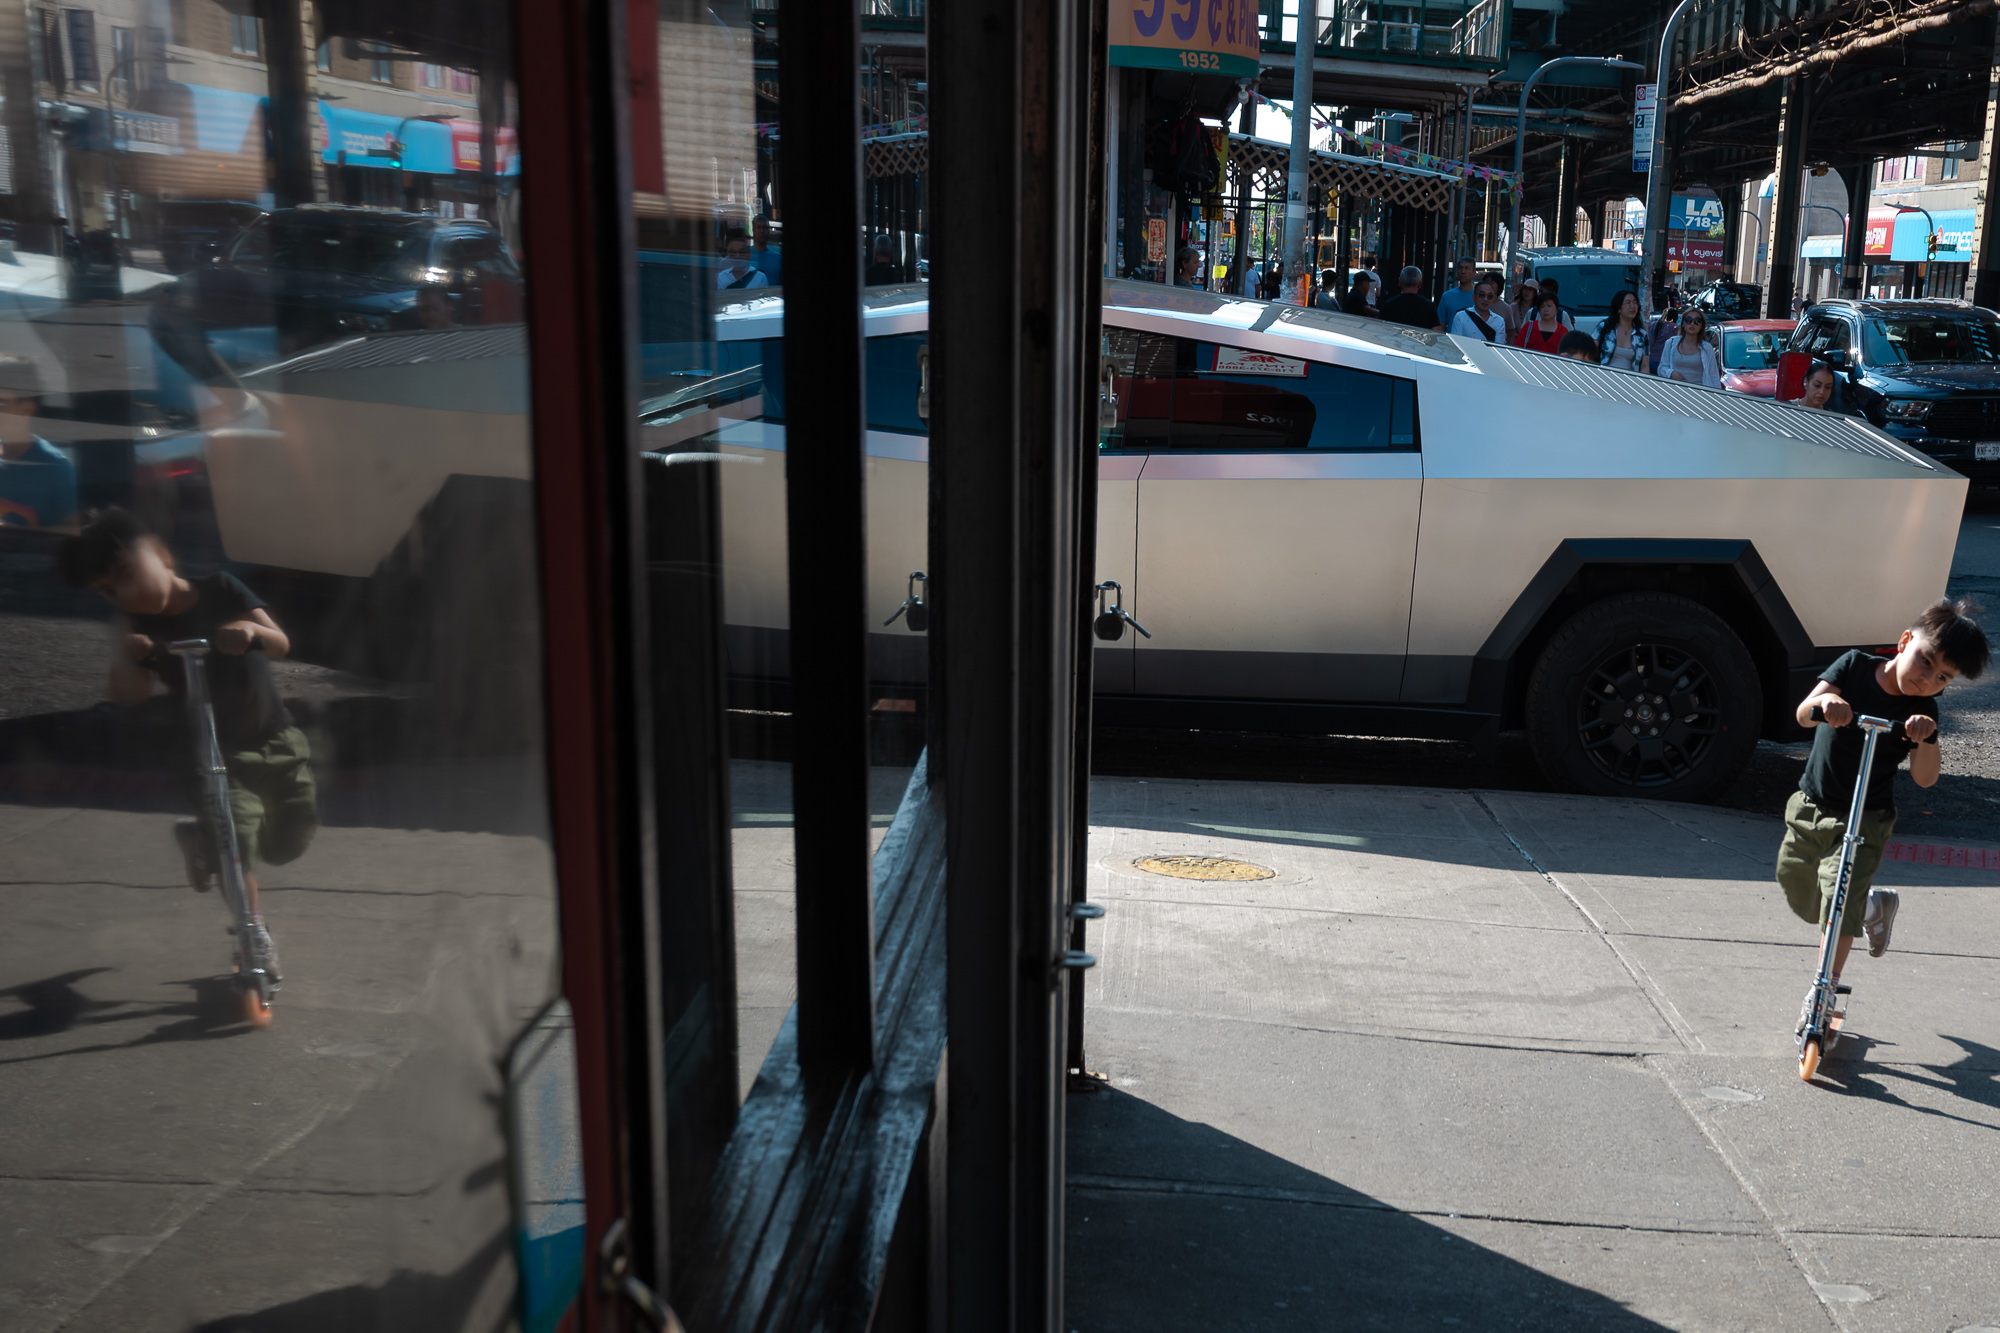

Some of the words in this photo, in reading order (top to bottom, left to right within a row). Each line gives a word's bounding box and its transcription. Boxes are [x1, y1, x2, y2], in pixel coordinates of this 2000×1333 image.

[1226, 0, 1236, 44] &
[1179, 51, 1220, 70] 1952
[1636, 115, 1643, 128] 2
[1686, 199, 1724, 218] LA
[1686, 216, 1724, 228] 718-
